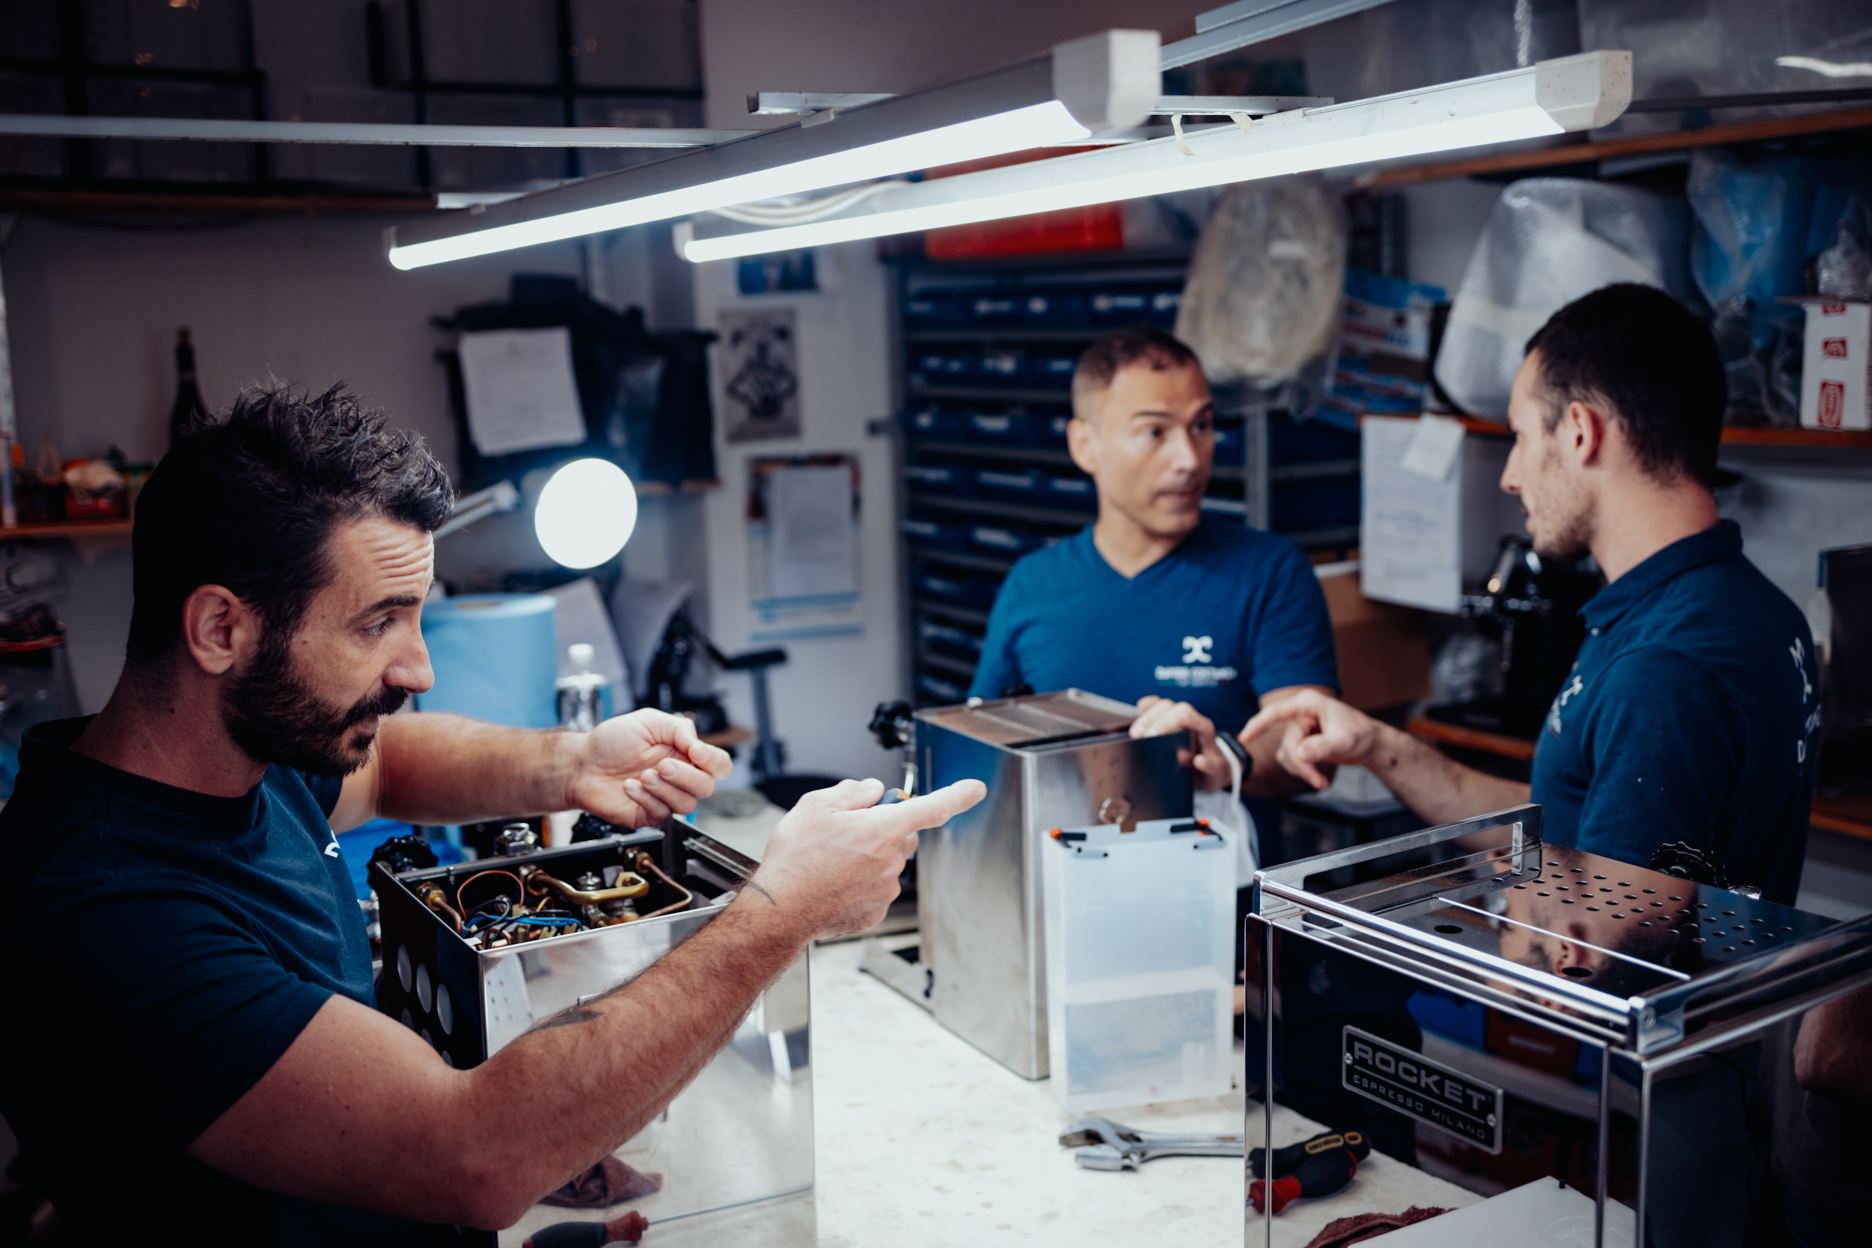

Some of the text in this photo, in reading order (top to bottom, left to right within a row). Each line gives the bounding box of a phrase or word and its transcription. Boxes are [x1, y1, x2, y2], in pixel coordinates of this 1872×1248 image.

[1353, 1074, 1486, 1139] ESPRESSO MILANO
[1354, 1041, 1486, 1110] ROCKET
